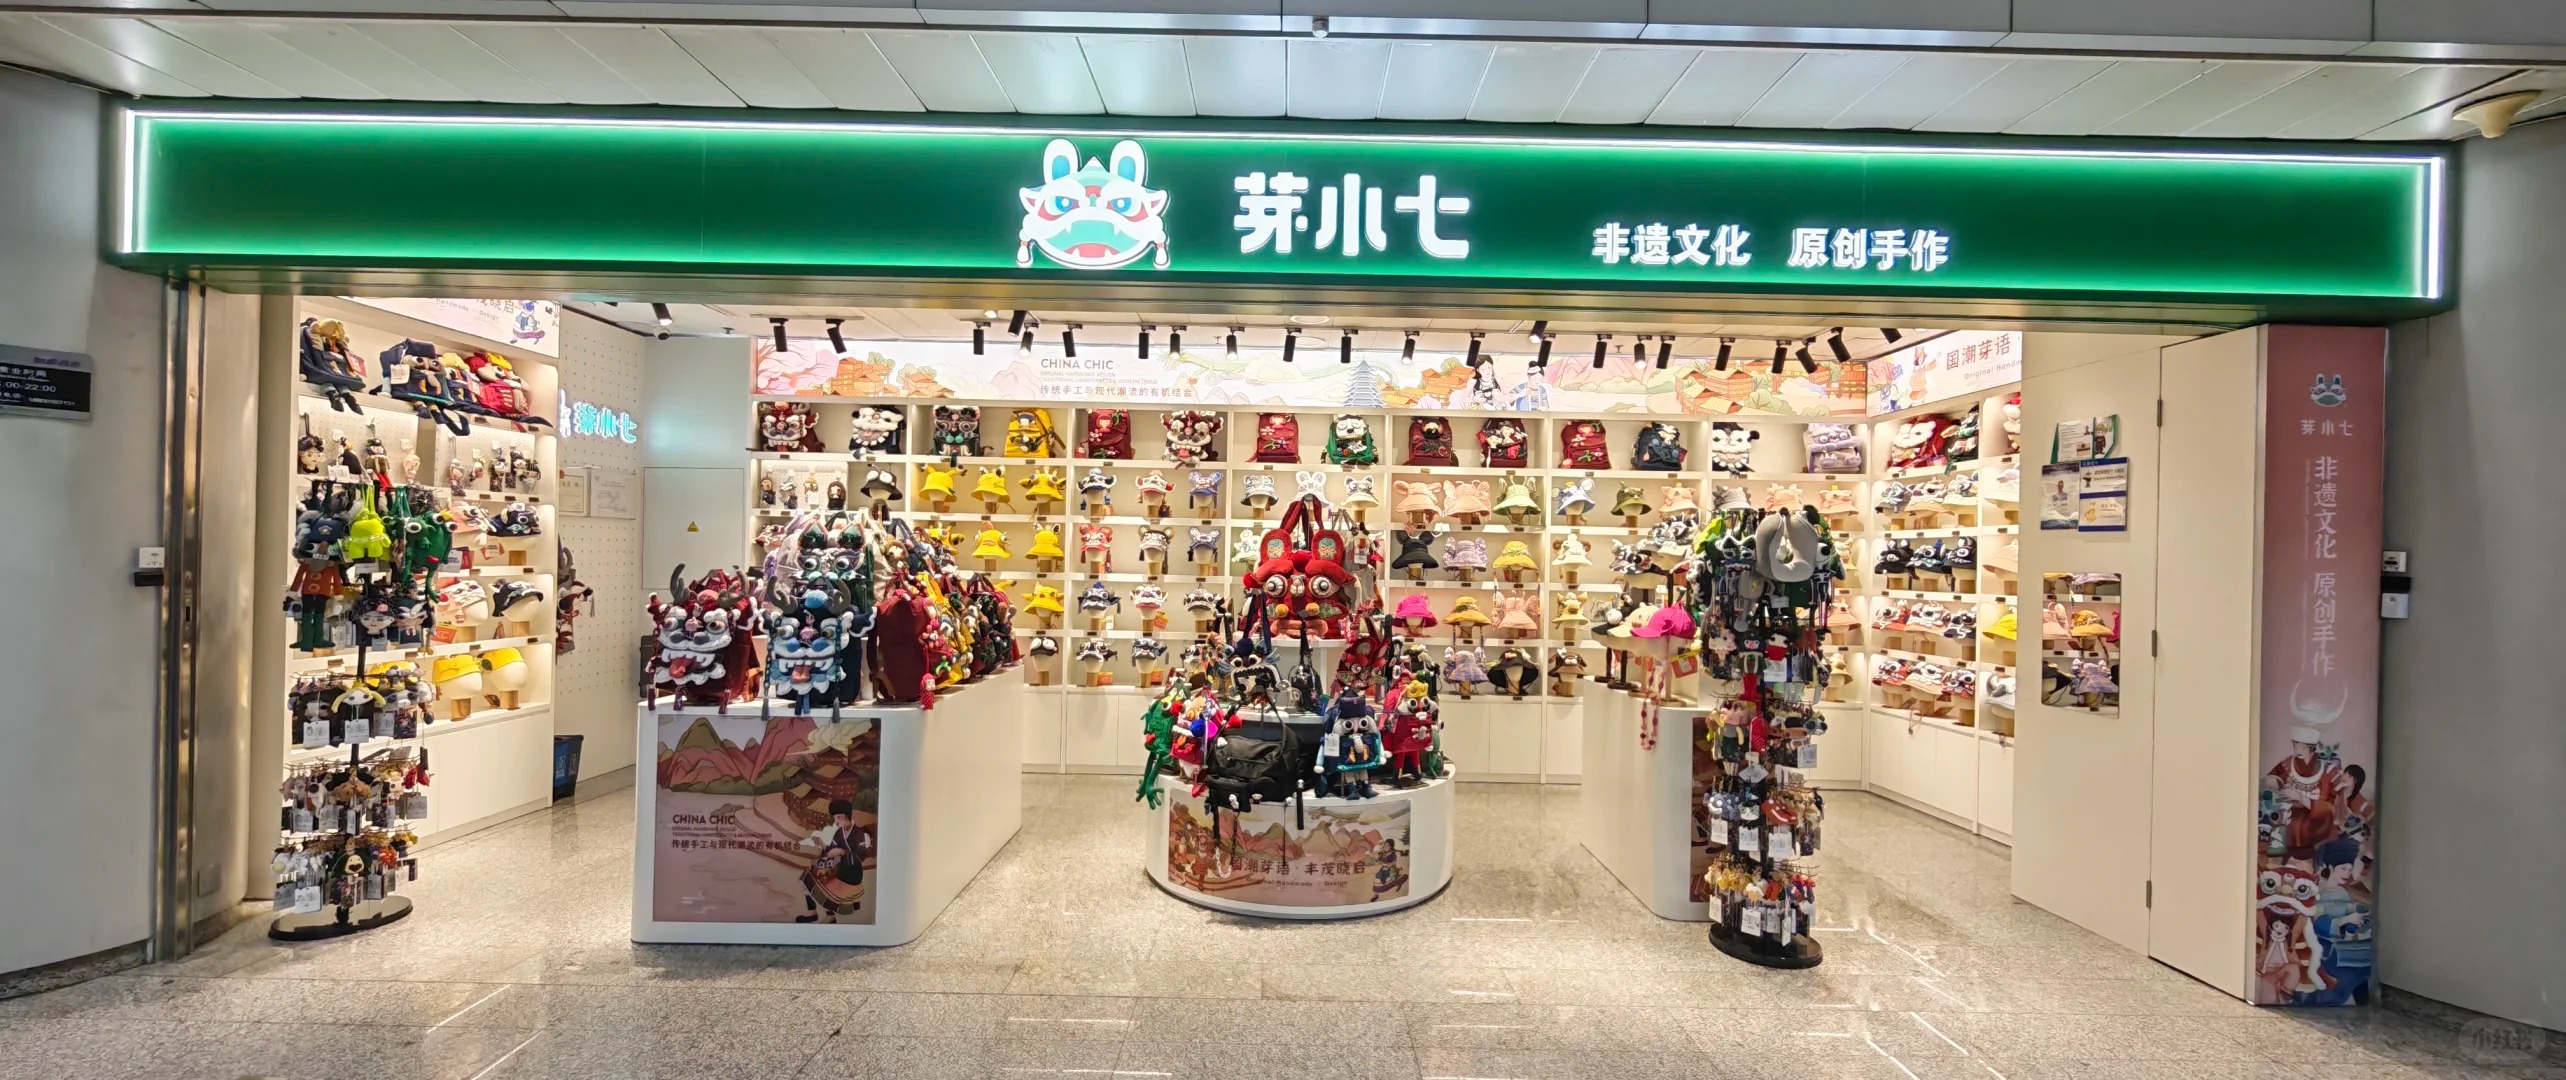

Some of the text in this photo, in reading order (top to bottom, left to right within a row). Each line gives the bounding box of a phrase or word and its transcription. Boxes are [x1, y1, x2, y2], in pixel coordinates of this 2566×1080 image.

[1234, 172, 1470, 258] 芽小七
[1592, 222, 1950, 271] 非遗文化 原创手作
[1040, 358, 1114, 370] CHINA CHIC
[1964, 366, 1994, 380] Original
[1040, 385, 1193, 398] 传统手工与现代潮流的有机结合
[2300, 419, 2354, 436] 芽小七
[2311, 456, 2338, 677] 非遗文化 原创手作
[672, 814, 735, 825] CHINA CHIC
